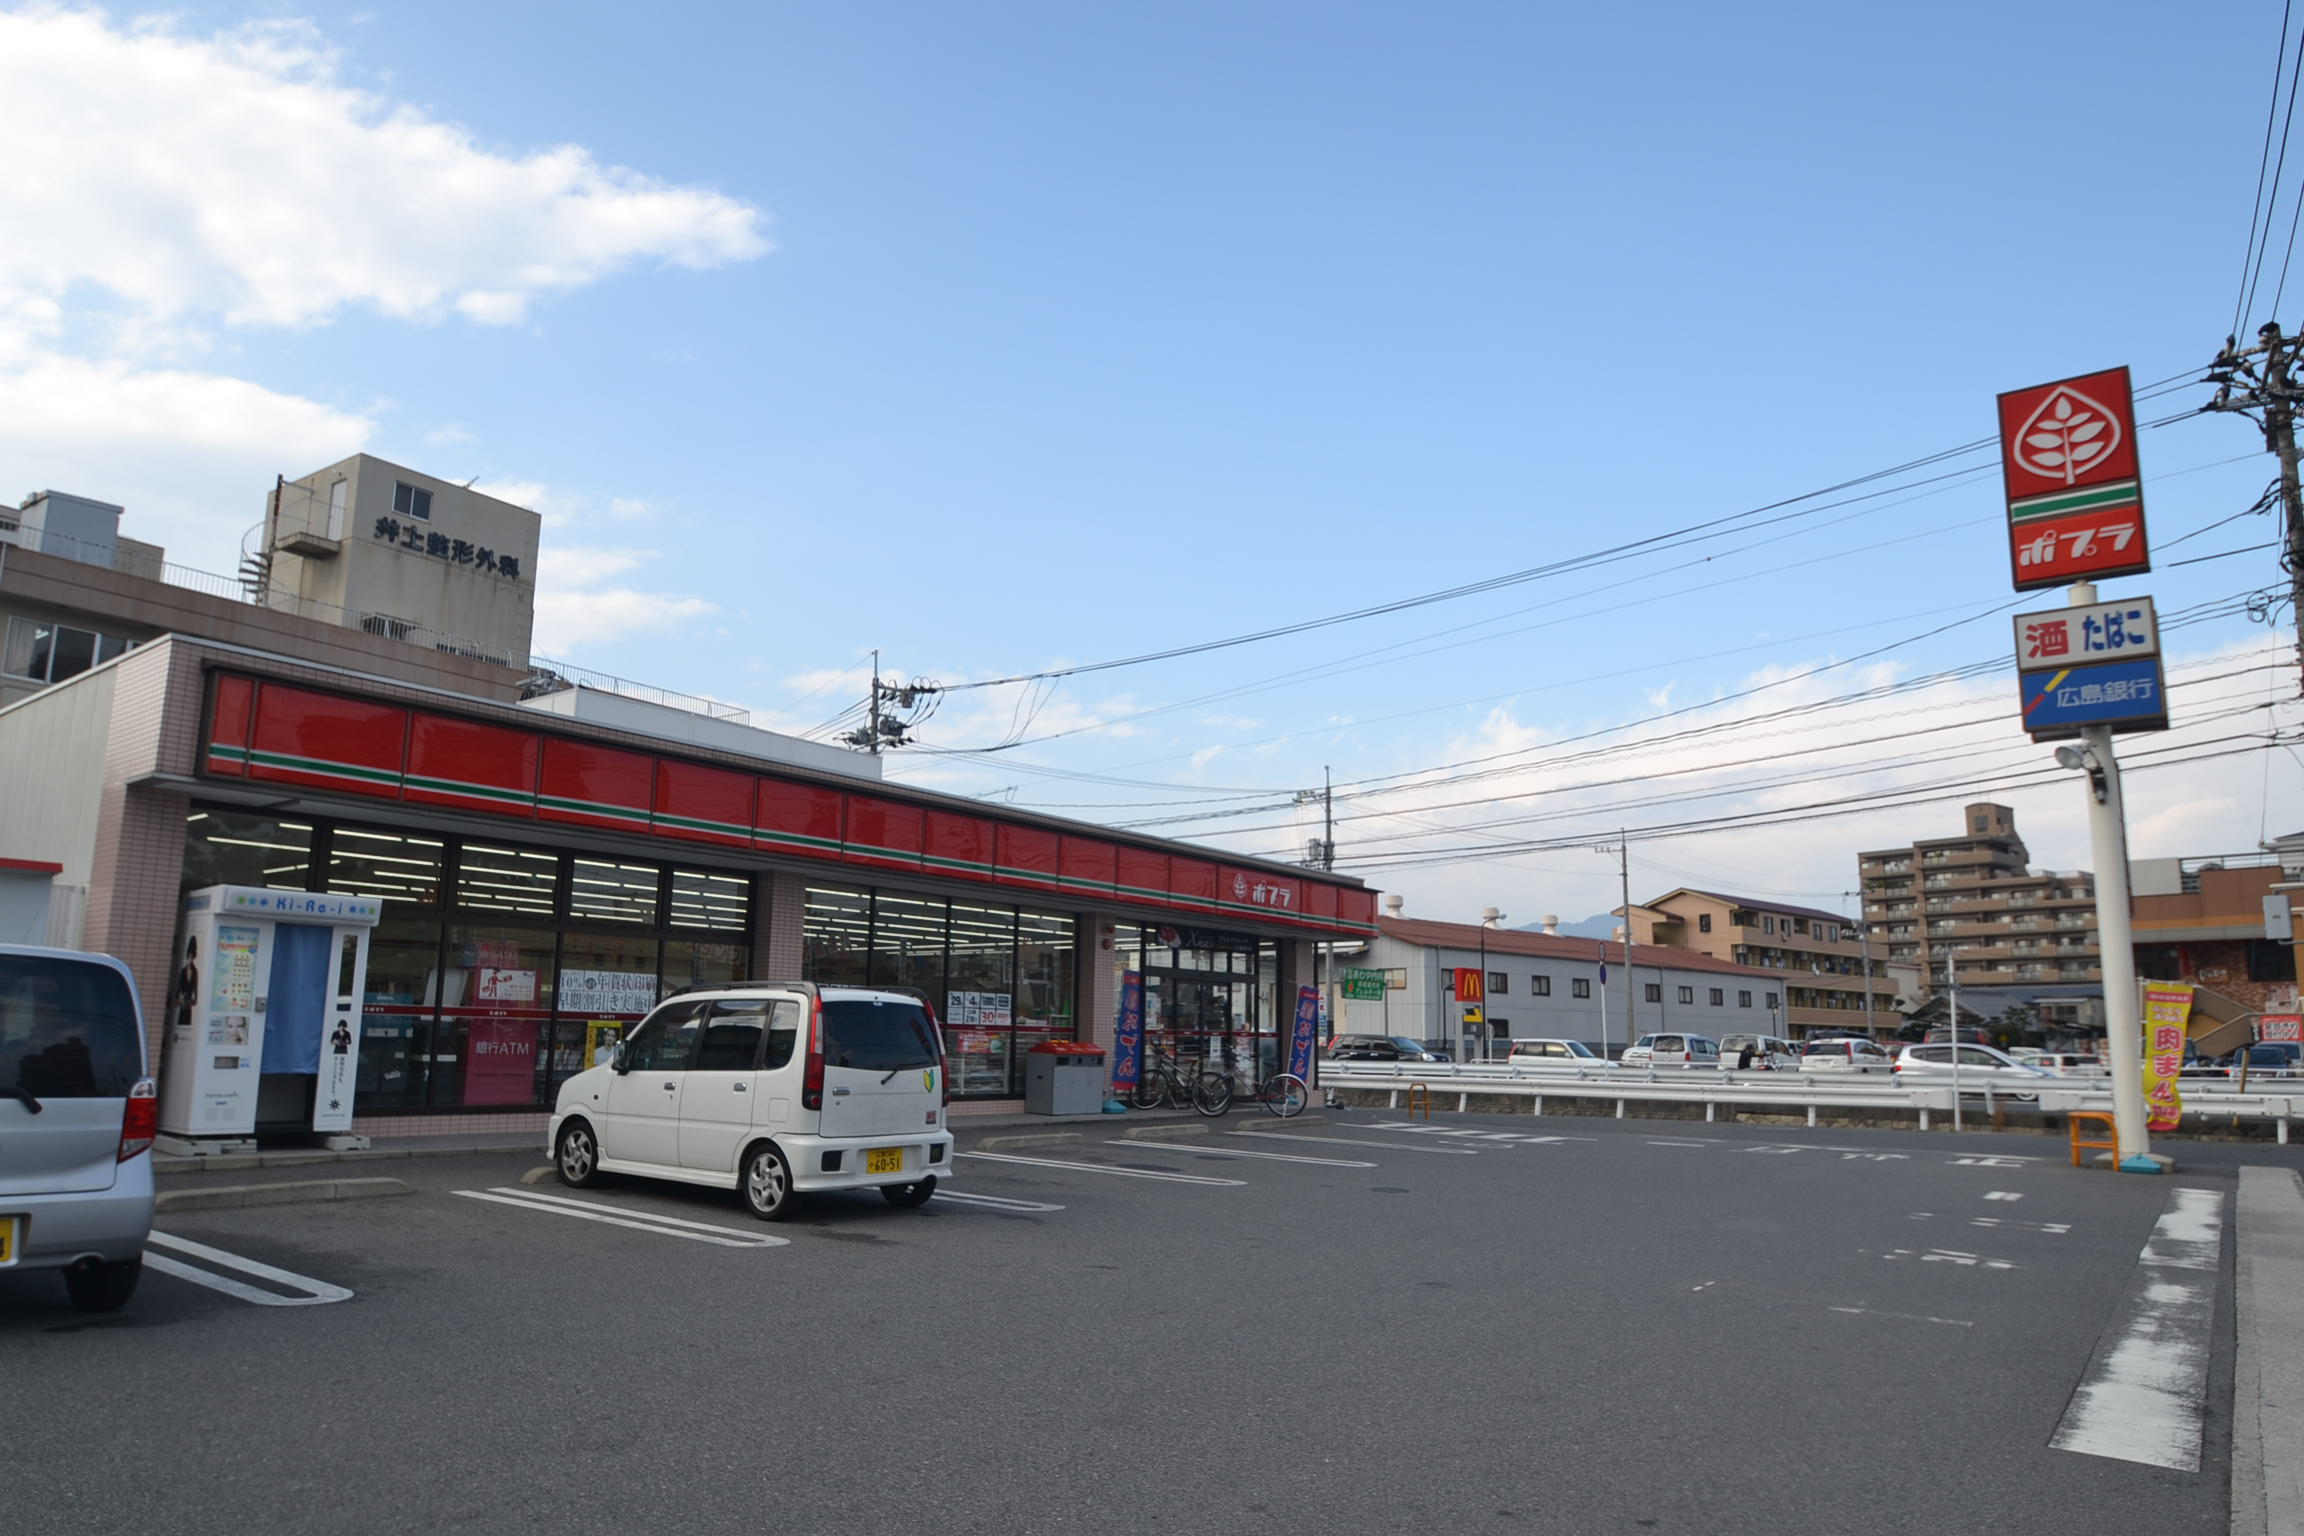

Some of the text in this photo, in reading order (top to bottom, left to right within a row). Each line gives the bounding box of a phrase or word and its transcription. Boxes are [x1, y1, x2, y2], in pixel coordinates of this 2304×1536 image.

[2019, 523, 2136, 567] ポプラ
[2025, 610, 2146, 658] 酒 たばこ
[2056, 678, 2154, 708] 広島銀行
[1252, 880, 1292, 907] ポプラ
[475, 1040, 530, 1056] 銀行ATM
[2151, 1025, 2183, 1102] 肉まん
